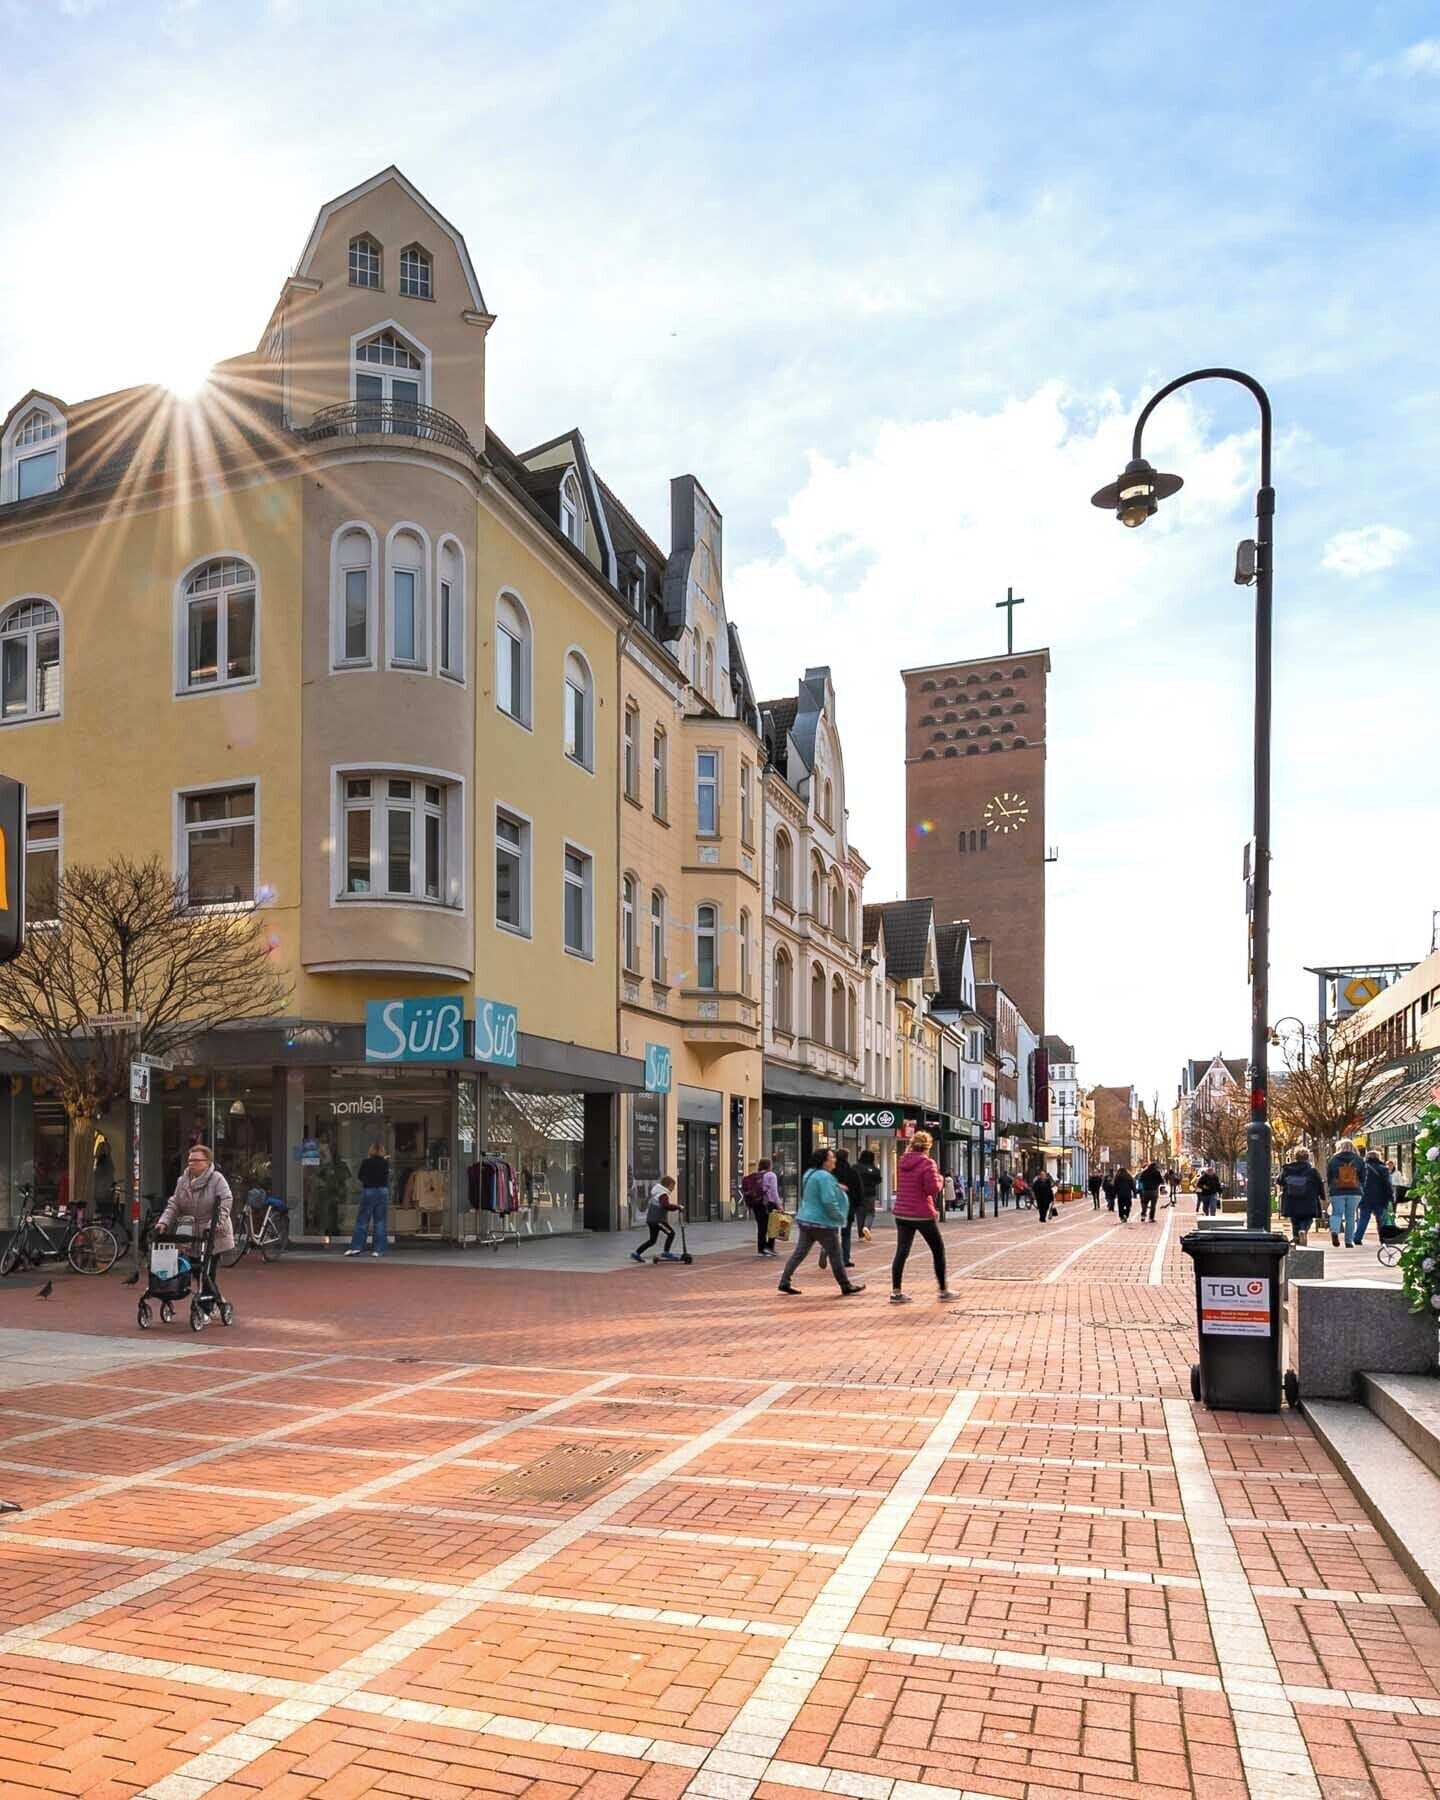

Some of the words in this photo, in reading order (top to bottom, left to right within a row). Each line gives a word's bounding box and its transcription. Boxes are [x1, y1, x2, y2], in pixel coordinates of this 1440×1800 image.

[366, 1002, 461, 1059] Süß
[475, 1002, 516, 1059] Süß
[645, 1046, 670, 1090] Süß
[841, 1112, 876, 1126] AOK
[1207, 1283, 1249, 1297] TBL
